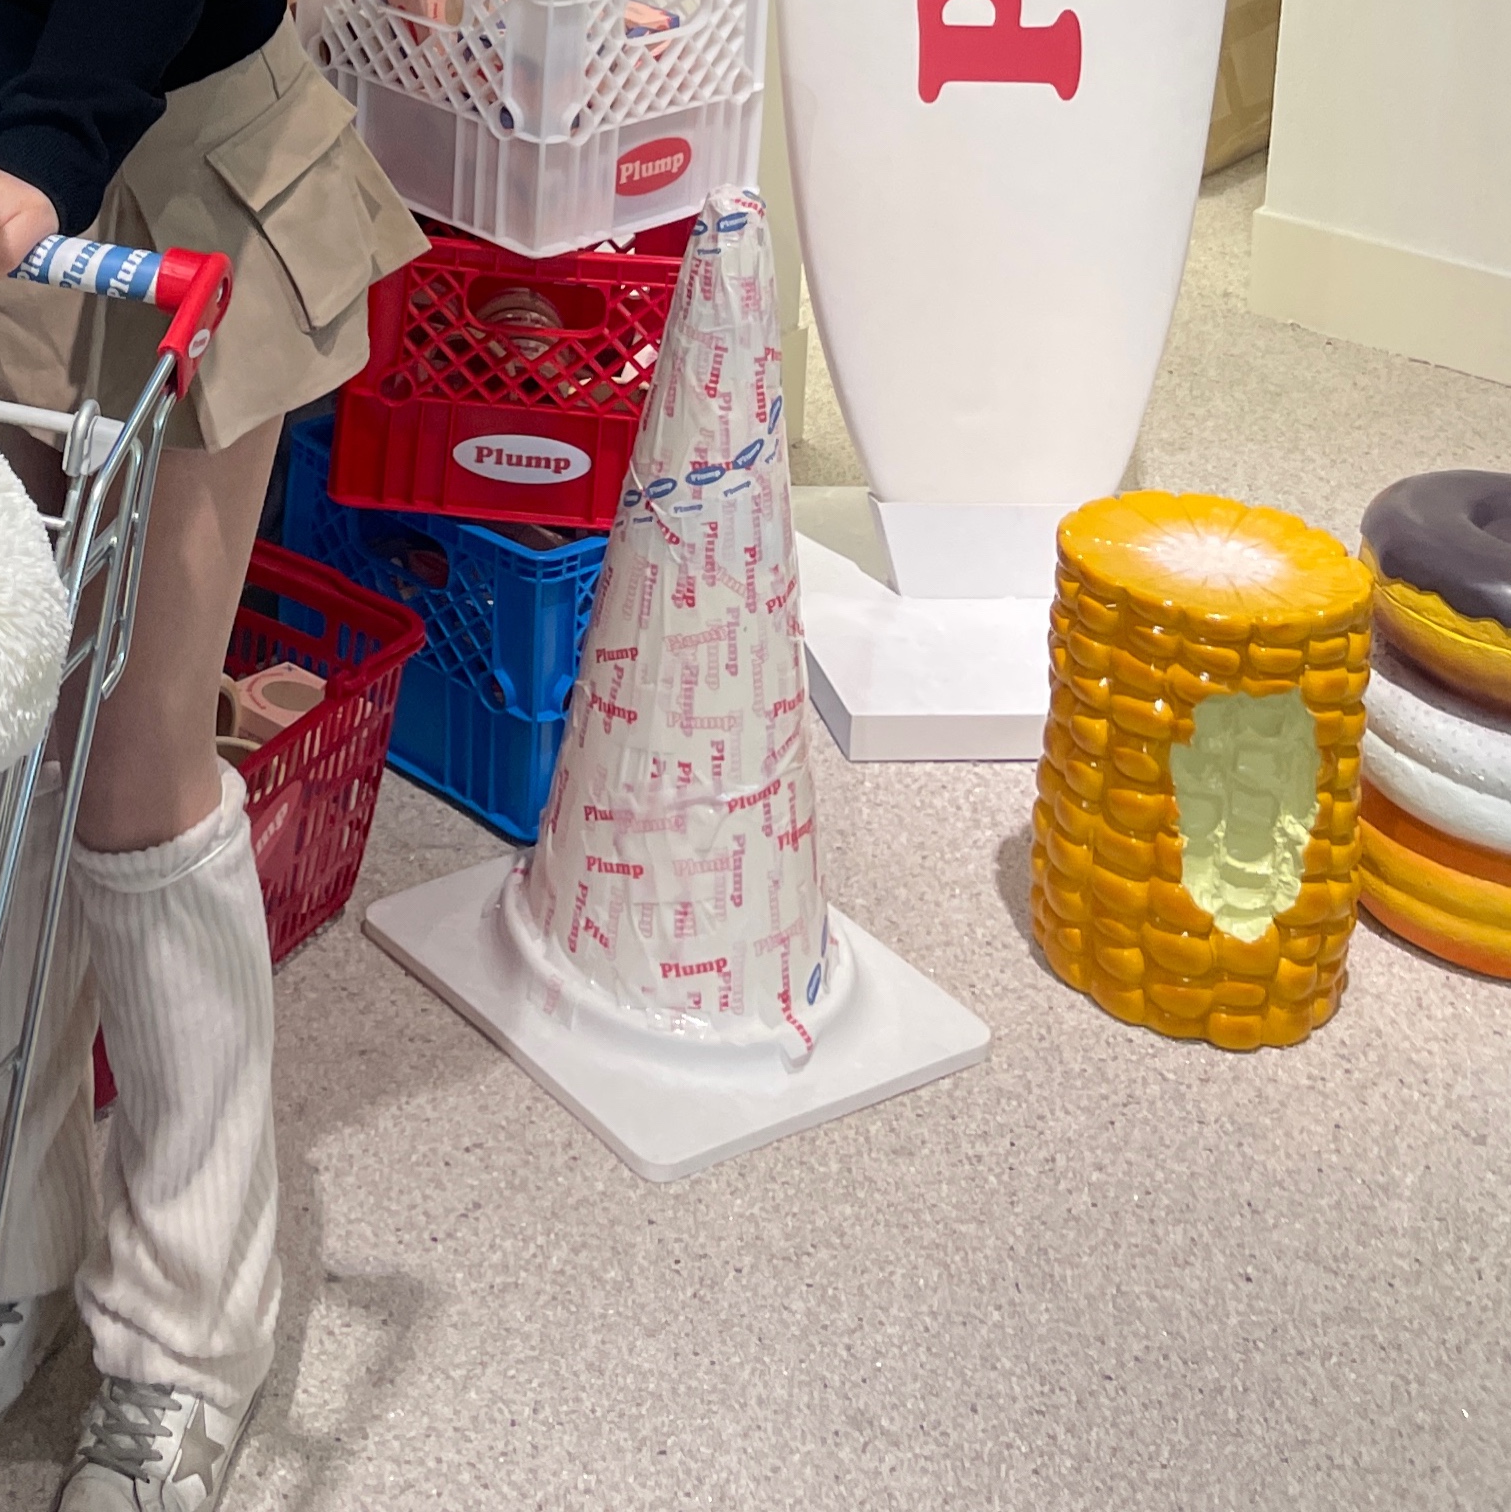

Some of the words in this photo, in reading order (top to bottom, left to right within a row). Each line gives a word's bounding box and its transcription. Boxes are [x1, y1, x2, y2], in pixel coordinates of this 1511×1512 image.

[618, 151, 685, 186] Plump
[473, 444, 573, 475] Plump
[595, 646, 639, 664] Plump
[588, 691, 639, 726] Plump
[726, 779, 782, 814] Plump
[585, 855, 645, 879] Plump
[659, 956, 729, 979] Plump
